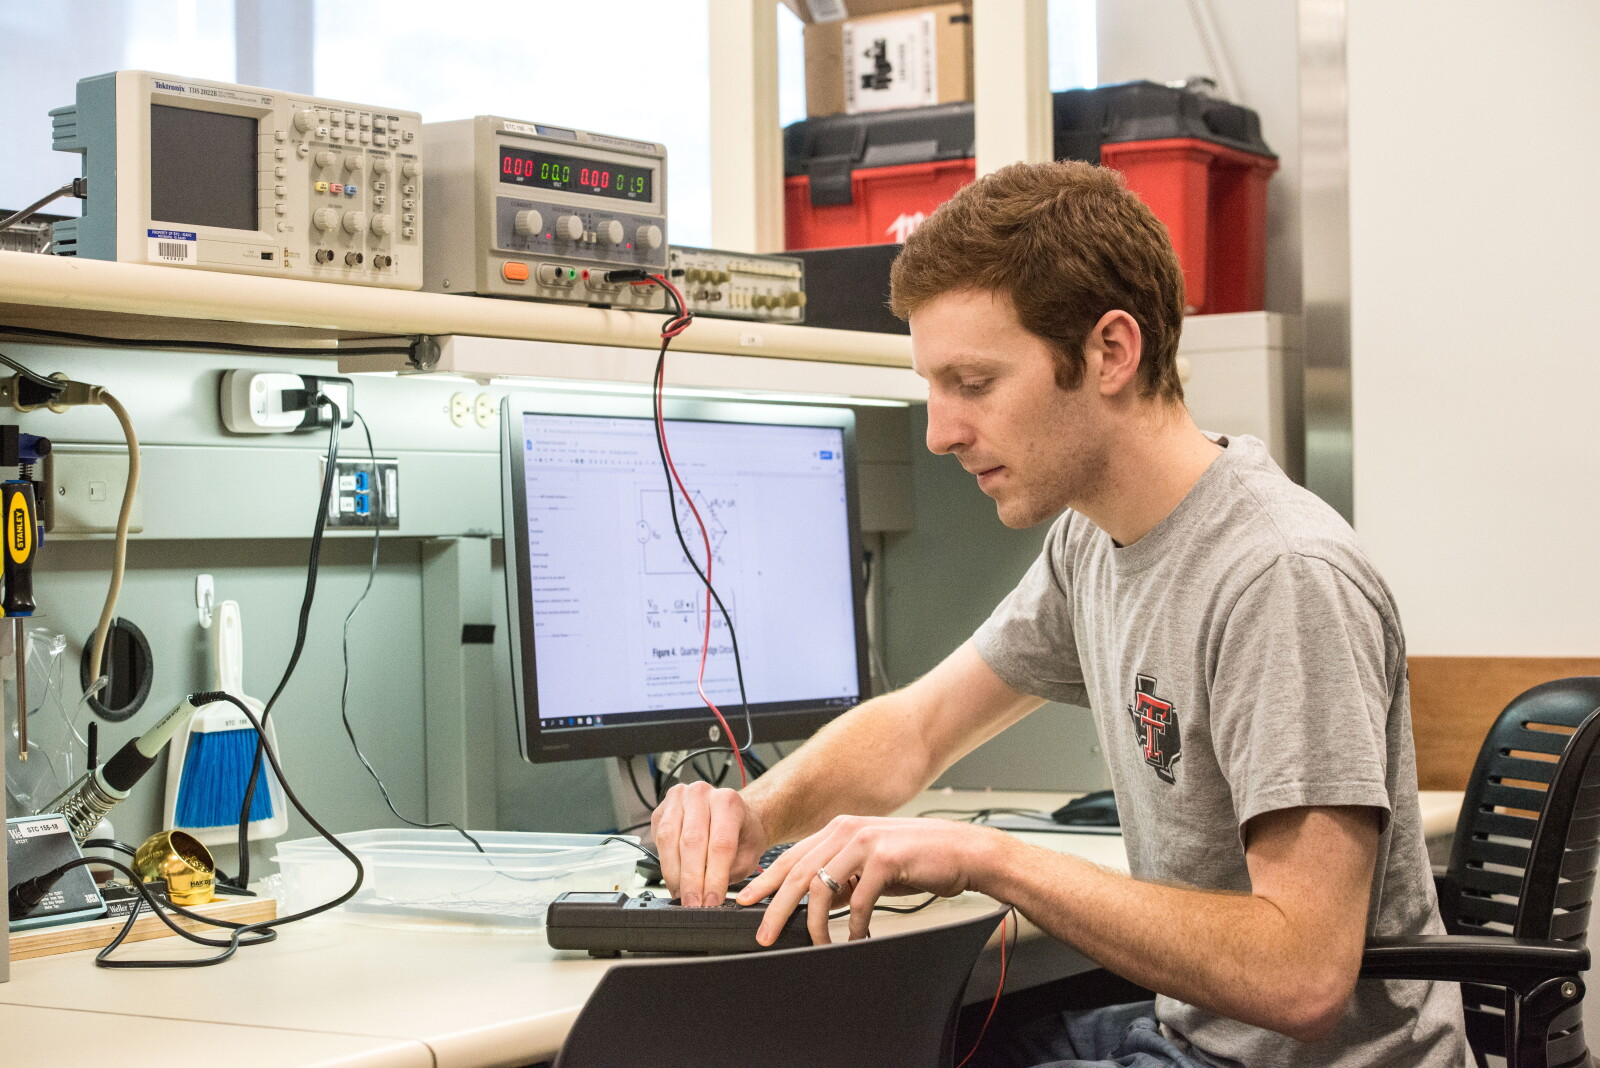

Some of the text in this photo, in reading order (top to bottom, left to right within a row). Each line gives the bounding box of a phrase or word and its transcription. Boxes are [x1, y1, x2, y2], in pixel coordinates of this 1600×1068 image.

[154, 81, 185, 92] Tektronix
[189, 86, 200, 94] TDS
[200, 87, 217, 97] 2022B
[16, 511, 24, 548] STANLEY
[652, 648, 670, 659] Figure
[27, 825, 40, 833] STC
[40, 823, 59, 832] 155-18
[109, 904, 128, 913] Weller
